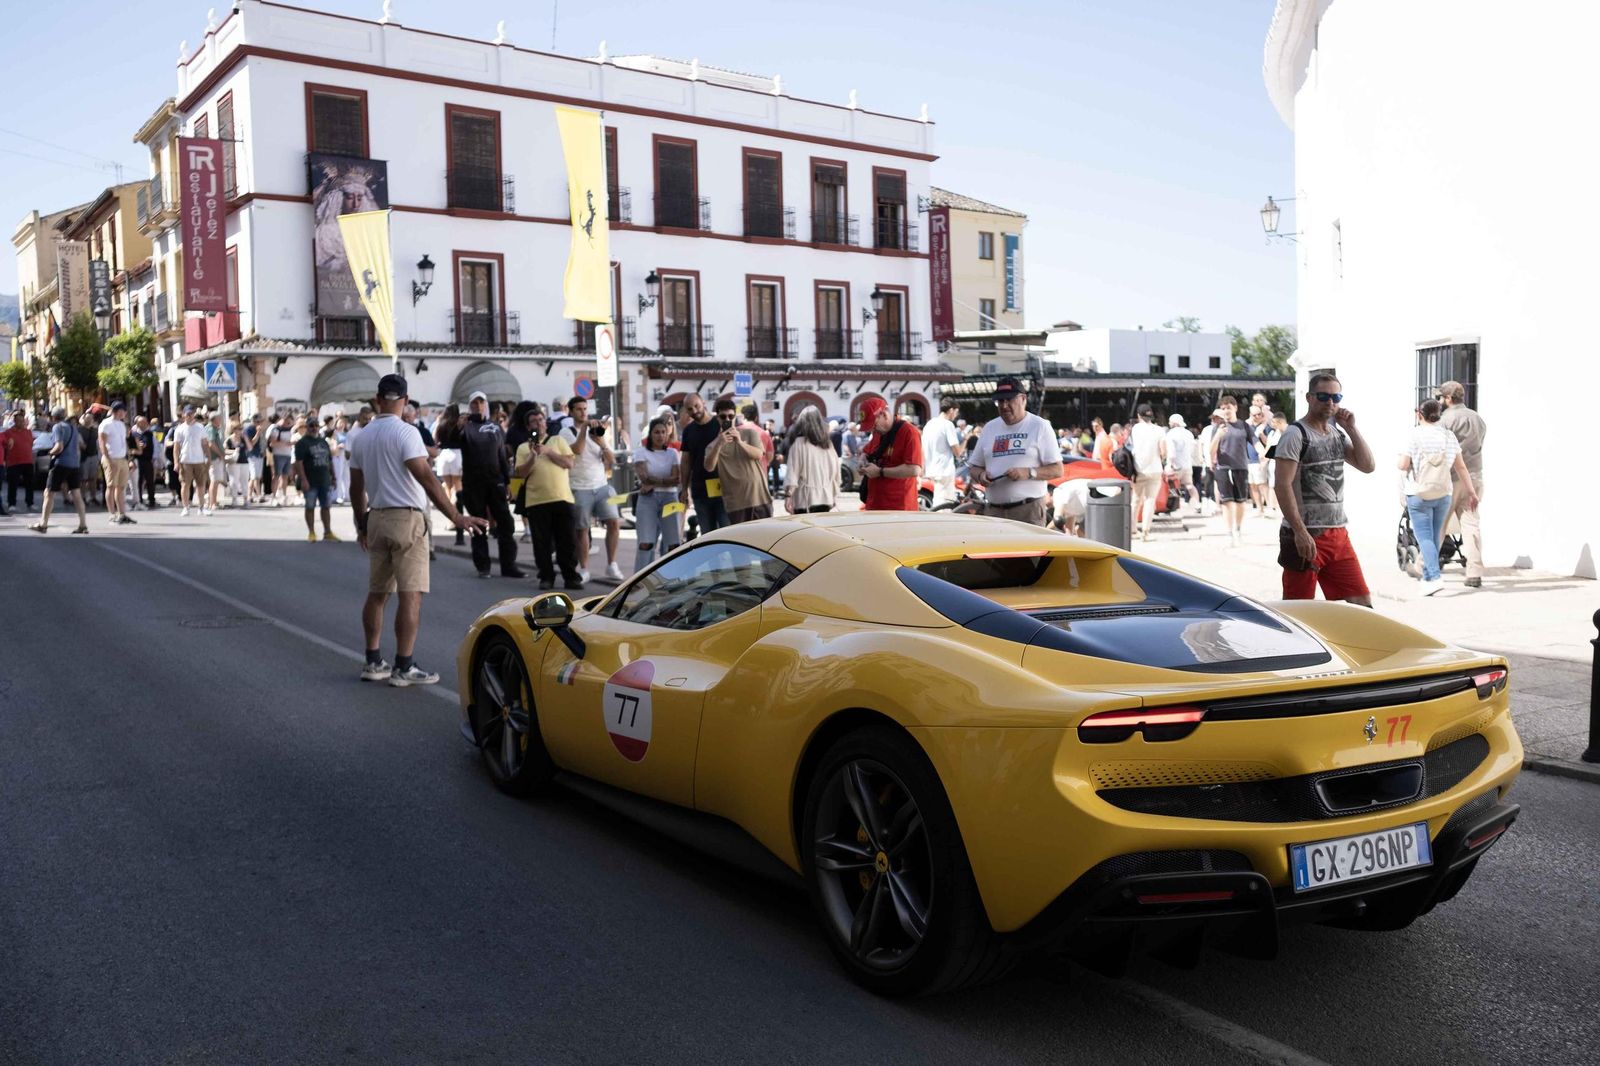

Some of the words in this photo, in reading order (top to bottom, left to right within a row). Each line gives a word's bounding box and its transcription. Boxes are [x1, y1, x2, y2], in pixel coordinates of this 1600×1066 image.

[205, 173, 218, 240] Jerez
[58, 245, 86, 253] HOTEL
[1006, 256, 1014, 304] HOTEL
[1013, 440, 1021, 448] Q
[614, 692, 640, 728] 77
[1387, 715, 1412, 748] 77
